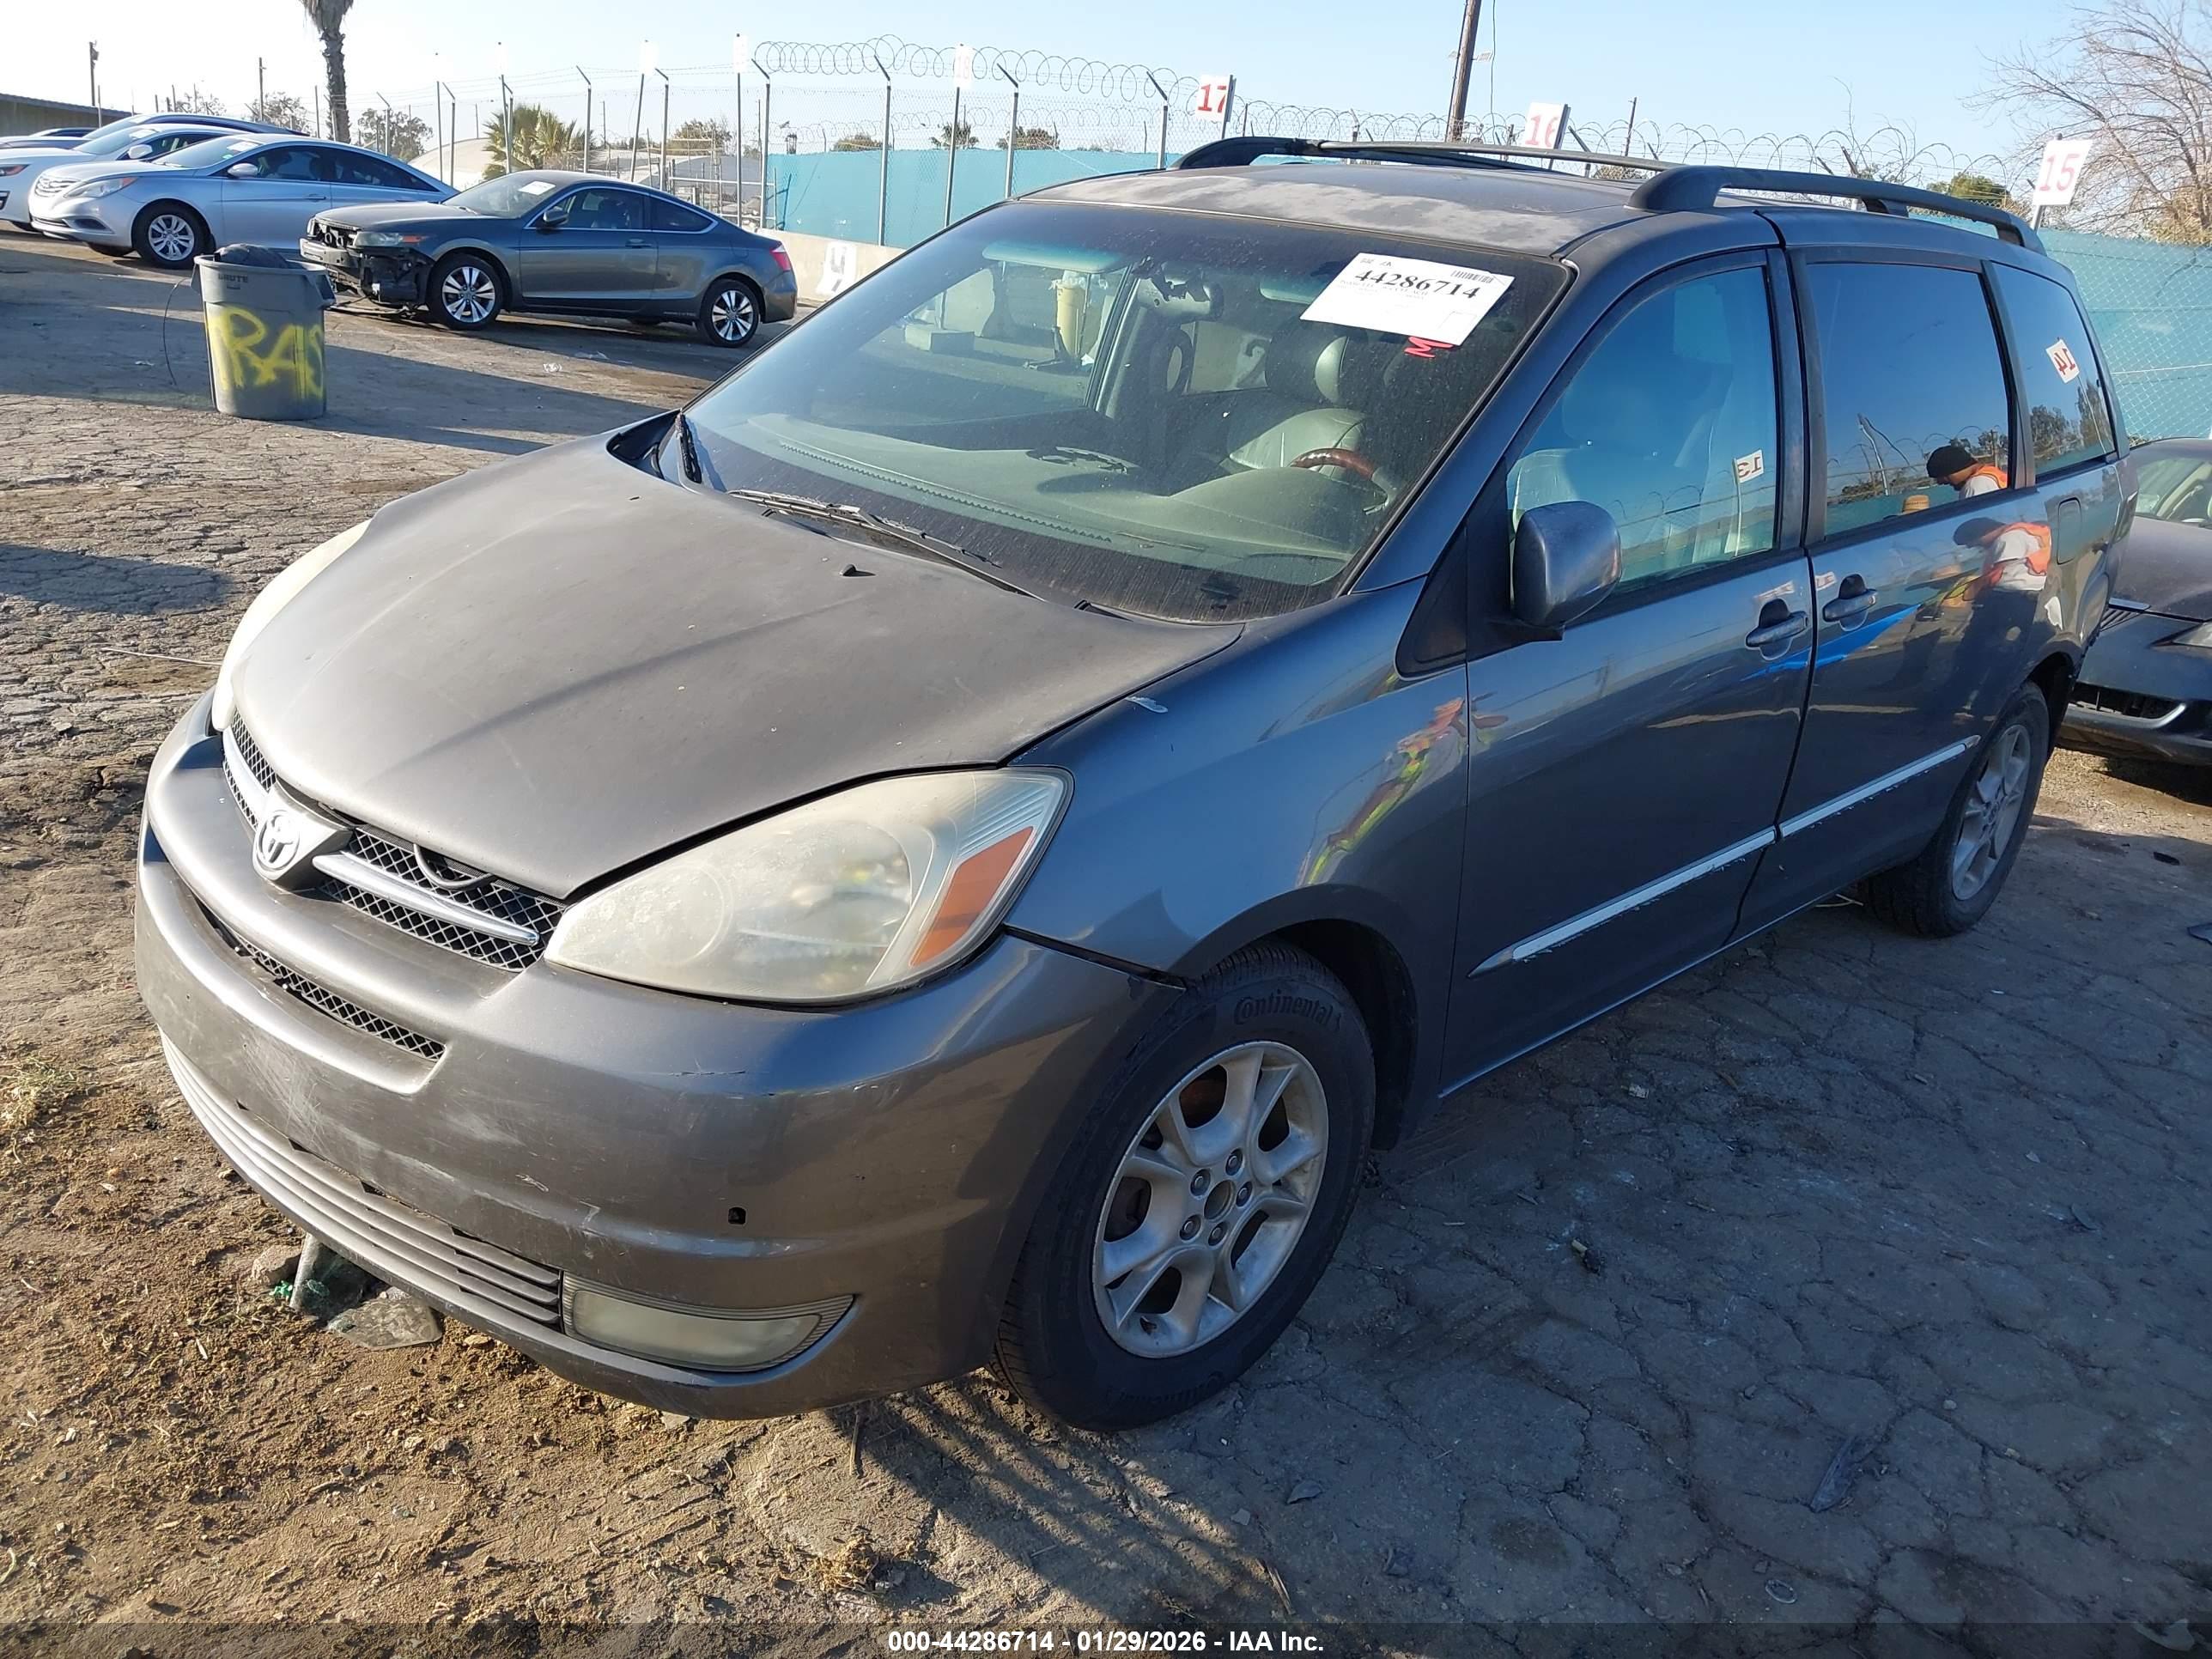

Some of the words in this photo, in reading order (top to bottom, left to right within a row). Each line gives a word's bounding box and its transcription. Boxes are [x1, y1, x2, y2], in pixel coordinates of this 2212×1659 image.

[1198, 83, 1227, 112] 17
[2039, 153, 2081, 191] 15
[1355, 270, 1481, 299] 44286714
[1233, 988, 1334, 1025] Continental
